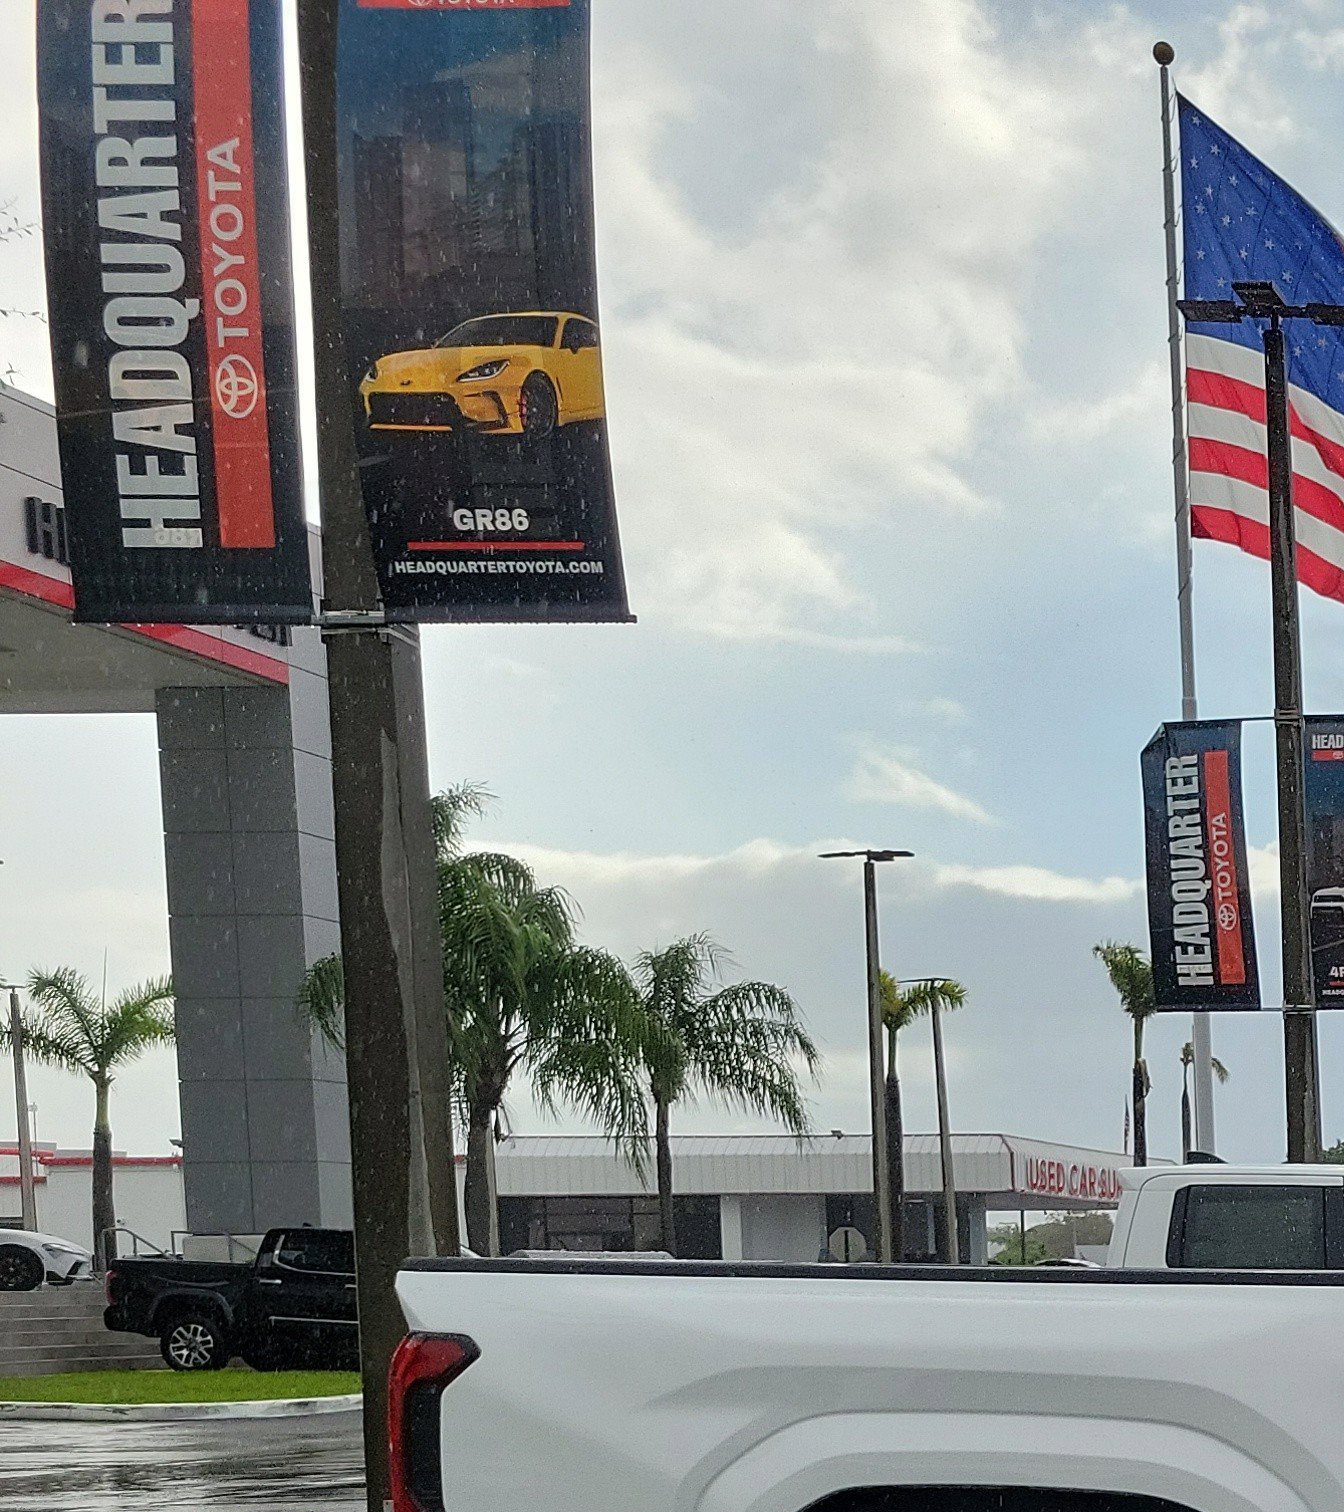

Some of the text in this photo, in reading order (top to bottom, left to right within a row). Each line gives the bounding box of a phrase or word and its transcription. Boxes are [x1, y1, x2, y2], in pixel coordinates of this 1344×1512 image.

[92, 0, 204, 548] HEADQUARTER
[207, 137, 250, 347] TOYOTA
[453, 508, 530, 531] GR86
[394, 561, 604, 574] HEADQUARTERTOYOTA.COM
[1165, 753, 1215, 986] HEADQUARTER
[1212, 812, 1235, 901] TOYOTA
[1026, 1157, 1065, 1194] USED
[1068, 1164, 1097, 1197] CAR
